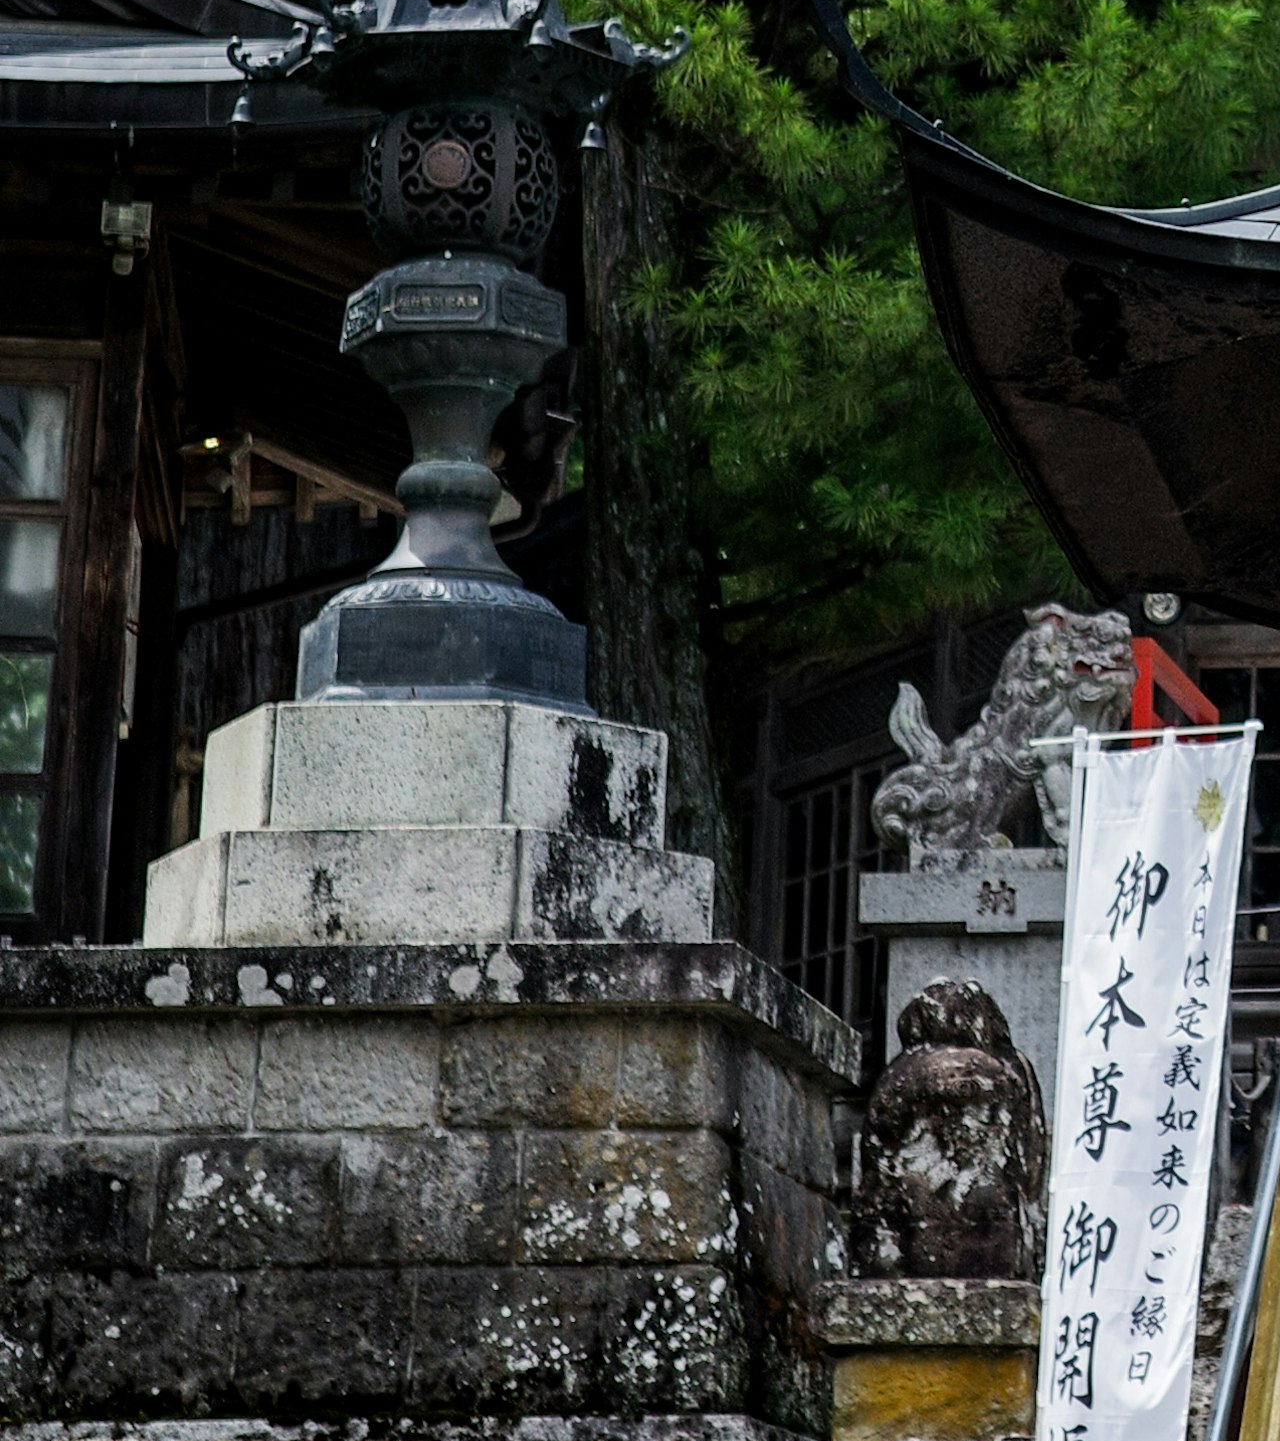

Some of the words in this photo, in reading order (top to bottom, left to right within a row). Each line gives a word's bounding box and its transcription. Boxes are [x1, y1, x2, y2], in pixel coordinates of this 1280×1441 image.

[975, 880, 1017, 917] 納
[1128, 850, 1214, 1385] 本日は定義如来のご縁日
